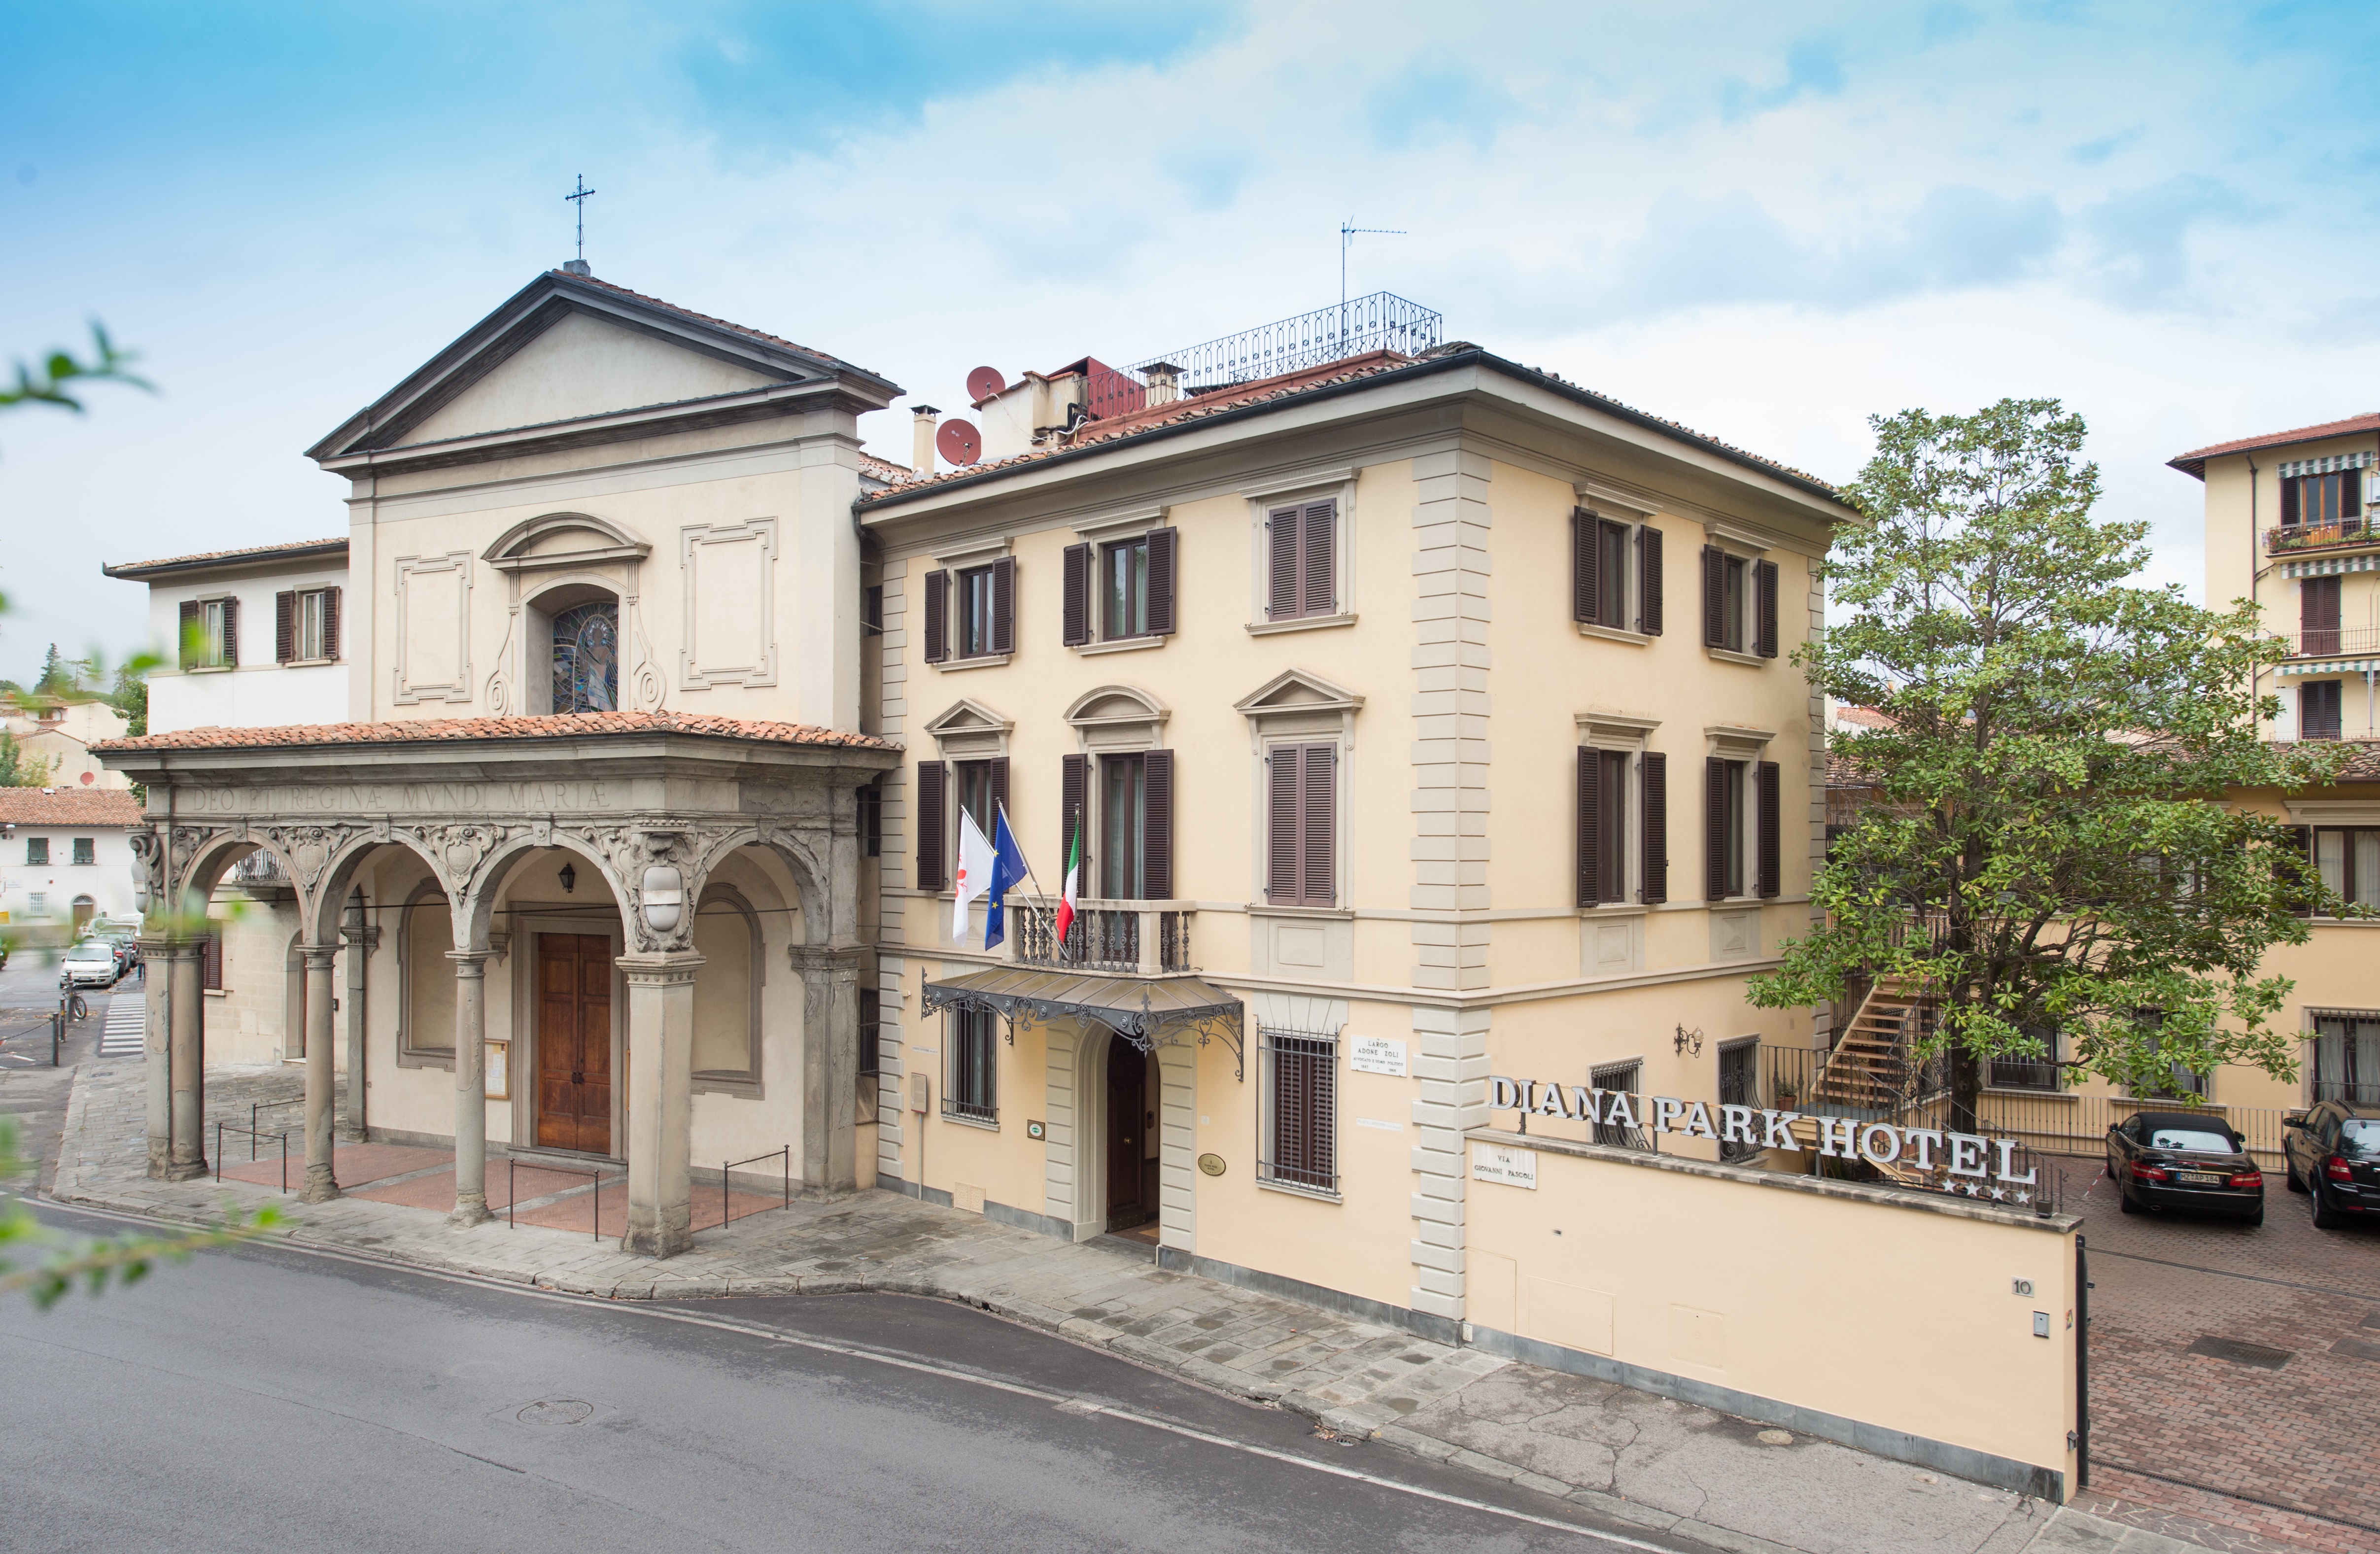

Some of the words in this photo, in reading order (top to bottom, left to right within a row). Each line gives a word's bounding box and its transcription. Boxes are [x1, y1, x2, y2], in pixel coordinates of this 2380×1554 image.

[193, 789, 235, 811] DEO
[248, 789, 276, 810] ET
[1488, 1076, 1642, 1128] DIANA
[1653, 1096, 1802, 1151] PARK
[1820, 1116, 2038, 1185] HOTEL
[1474, 1165, 1502, 1174] GIOVANNI
[1508, 1170, 1533, 1180] PASCOLI
[2014, 1279, 2031, 1294] 10
